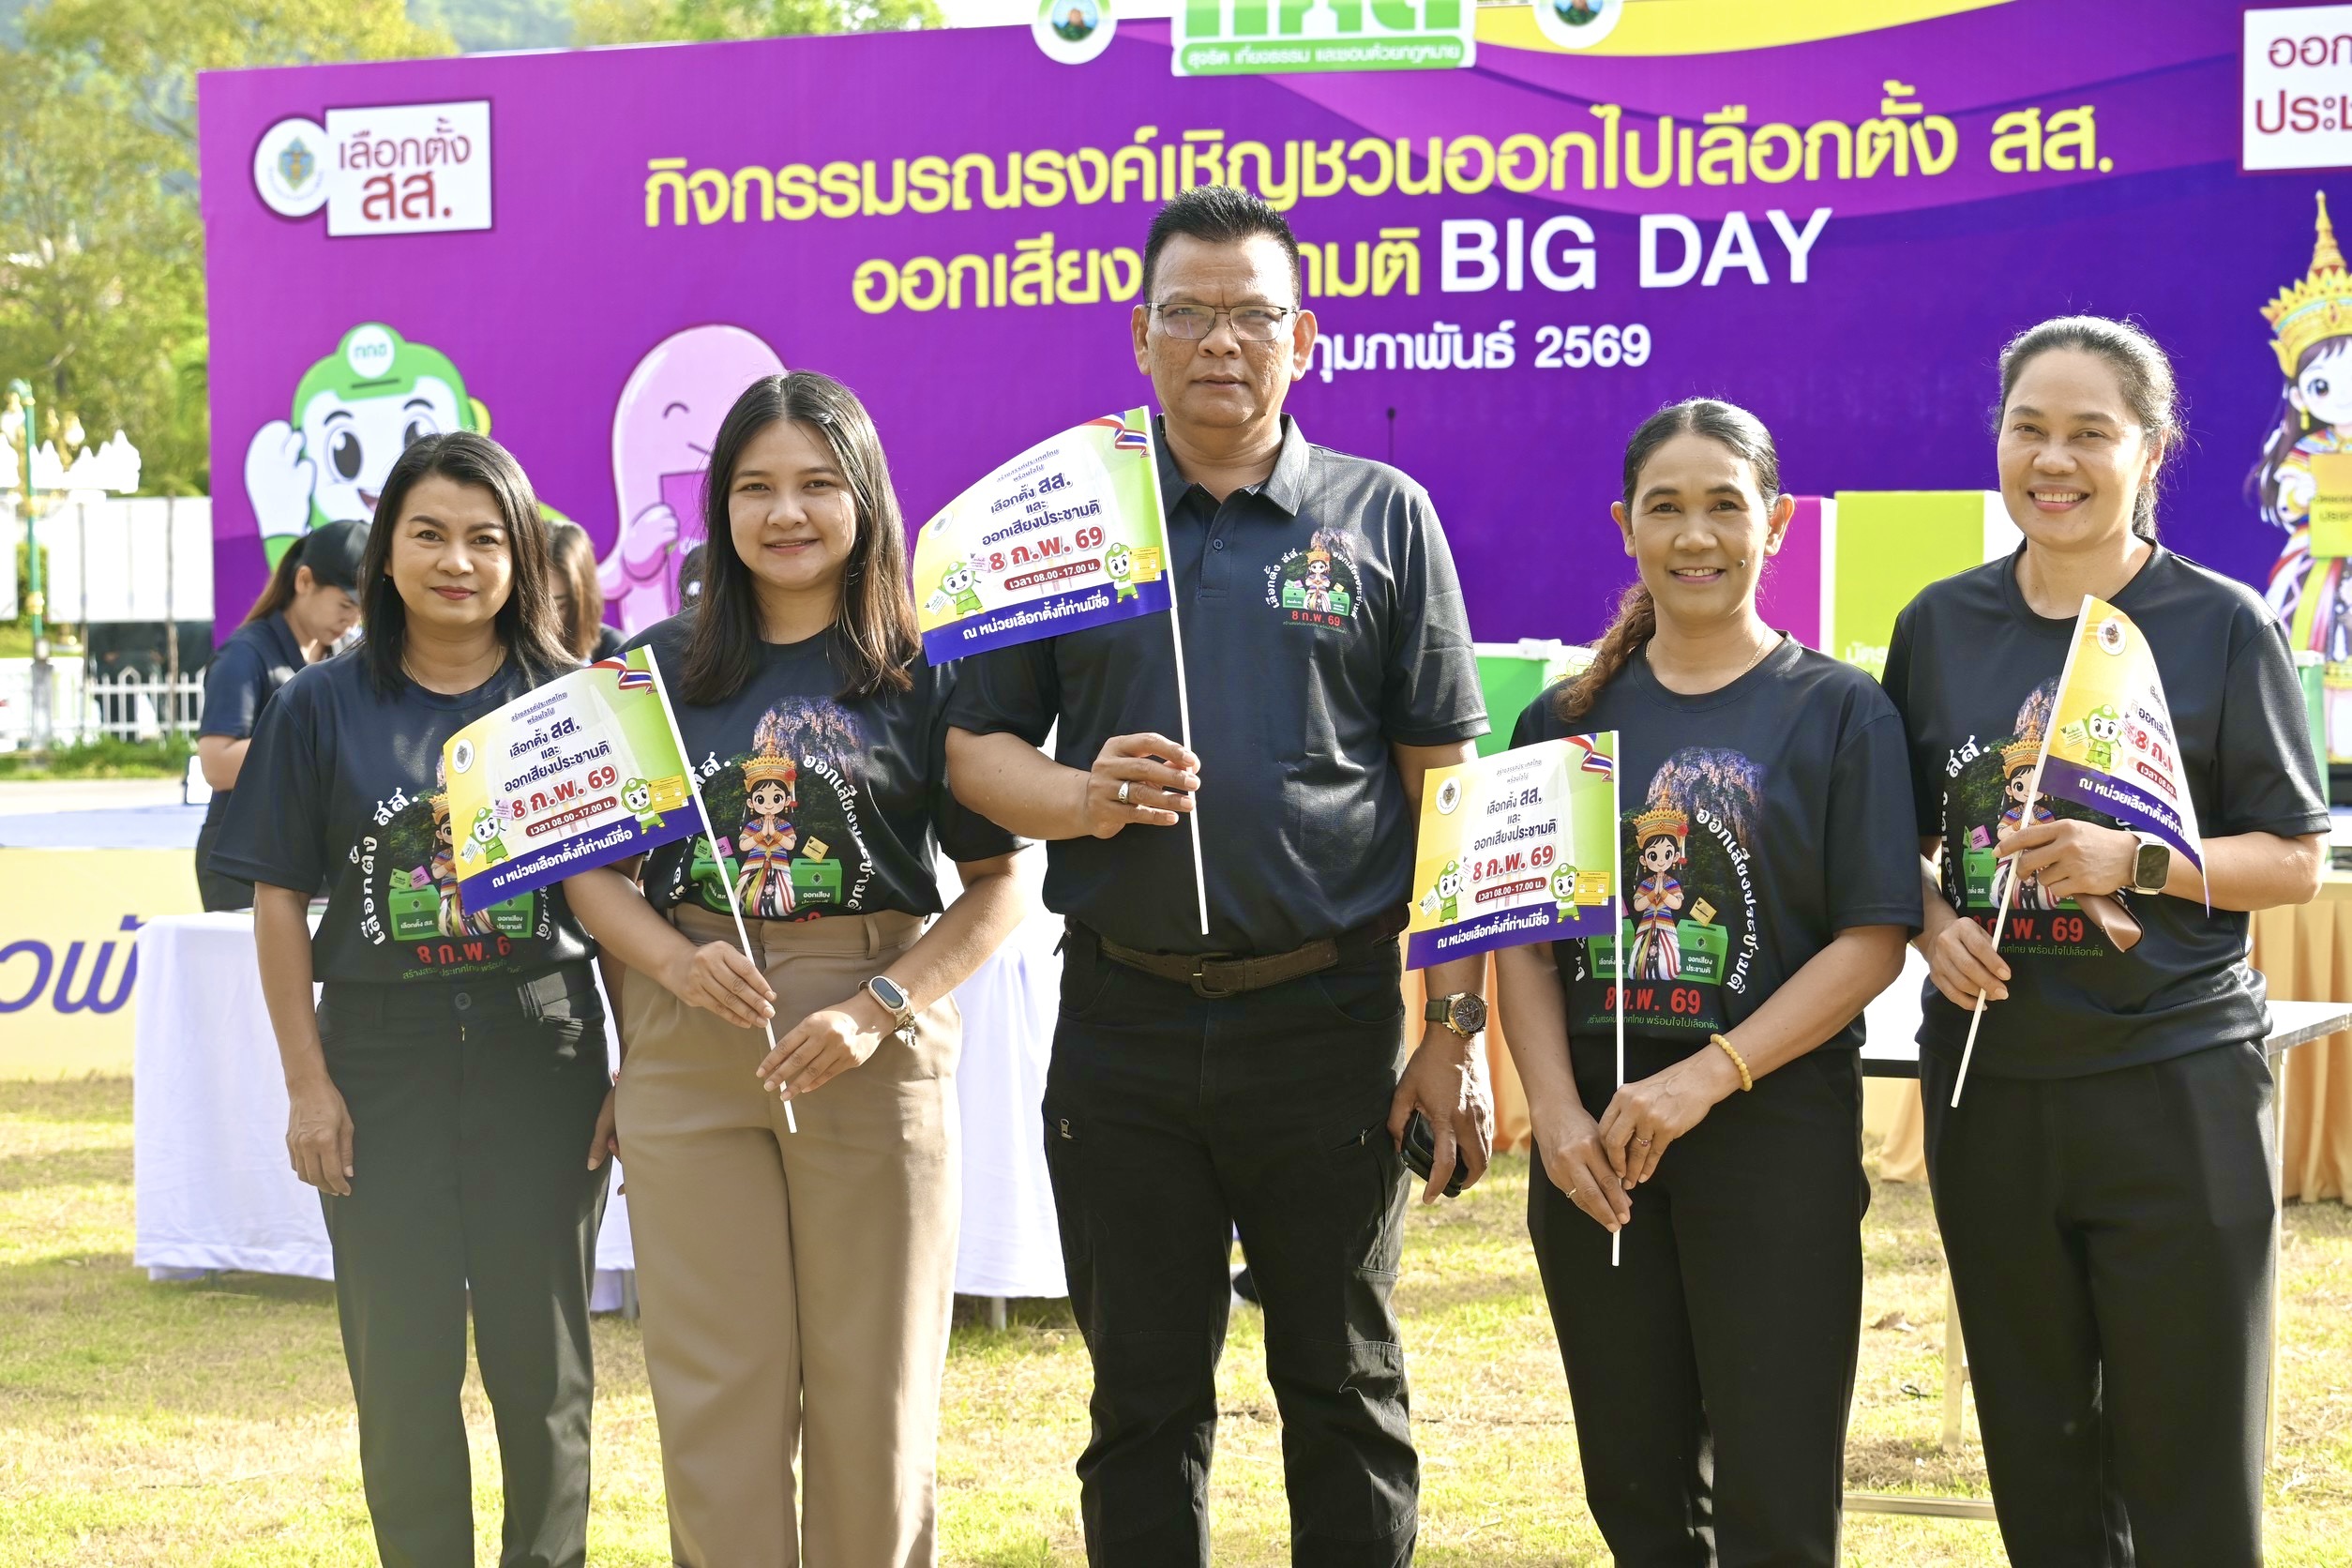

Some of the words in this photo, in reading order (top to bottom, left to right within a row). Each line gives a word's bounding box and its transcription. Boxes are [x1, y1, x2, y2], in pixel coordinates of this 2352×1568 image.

[339, 116, 472, 171] เลือกตั้ง
[1989, 105, 2114, 173] สส.
[361, 171, 453, 221] สส.
[1440, 215, 1596, 293] BIG
[1639, 206, 1833, 289] DAY
[1534, 323, 1652, 369] 2569
[990, 483, 1036, 515] เลือกตั้ง
[1038, 473, 1073, 495] สส.
[1025, 500, 1048, 515] และ
[982, 499, 1102, 546] ออกเสียงประชามติ
[989, 552, 1005, 572] 8
[1010, 536, 1071, 566] ก.พ.
[1075, 526, 1105, 549] 69
[1009, 574, 1033, 590] เวลา
[1087, 561, 1098, 572] น.
[962, 627, 978, 641] ณ
[979, 589, 1110, 638] หน่วยเลือกตั้งที่ท่านมีชื่อ
[1290, 611, 1300, 620] 8
[1302, 611, 1325, 624] ก.พ.
[1328, 614, 1342, 626] 69
[509, 729, 549, 759] เลือกตั้ง
[550, 716, 581, 741] สส.
[540, 745, 563, 761] และ
[1945, 734, 1991, 778] สส.
[2136, 730, 2149, 751] 8
[504, 740, 611, 793] ออกเสียงประชามติ
[2079, 776, 2093, 792] ณ
[511, 799, 527, 819] 8
[530, 778, 586, 812] ก.พ.
[587, 764, 618, 791] 69
[1486, 792, 1517, 815] เลือกตั้ง
[1519, 786, 1543, 807] สส.
[530, 821, 551, 837] เวลา
[603, 799, 615, 810] น.
[1473, 819, 1558, 851] ออกเสียงประชามติ
[1507, 813, 1521, 825] และ
[348, 837, 386, 945] เลือกตั้ง
[373, 787, 419, 827] สส.
[491, 874, 505, 889] ณ
[505, 823, 634, 886] หน่วยเลือกตั้งที่ท่านมีชื่อ
[1473, 862, 1483, 881] 8
[1486, 852, 1527, 877] ก.พ.
[1530, 845, 1555, 867] 69
[1478, 892, 1494, 903] เวลา
[1535, 880, 1545, 889] น.
[1696, 808, 1759, 995] ออกเสียงประชามติ
[1437, 939, 1448, 949] ณ
[1449, 907, 1550, 948] หน่วยเลือกตั้งที่ท่านมีชื่อ
[2051, 916, 2085, 943] 69
[416, 945, 432, 964] 8
[438, 942, 490, 965] ก.พ.
[1687, 956, 1713, 965] ออกเสียง
[2028, 943, 2104, 957] พร้อมใจไปเลือกตั้ง
[1686, 965, 1711, 974] ประชามติ
[1605, 987, 1617, 1011] 8
[1670, 988, 1702, 1015] 69
[1646, 1015, 1719, 1030] พร้อมใจไปเลือกตั้ง
